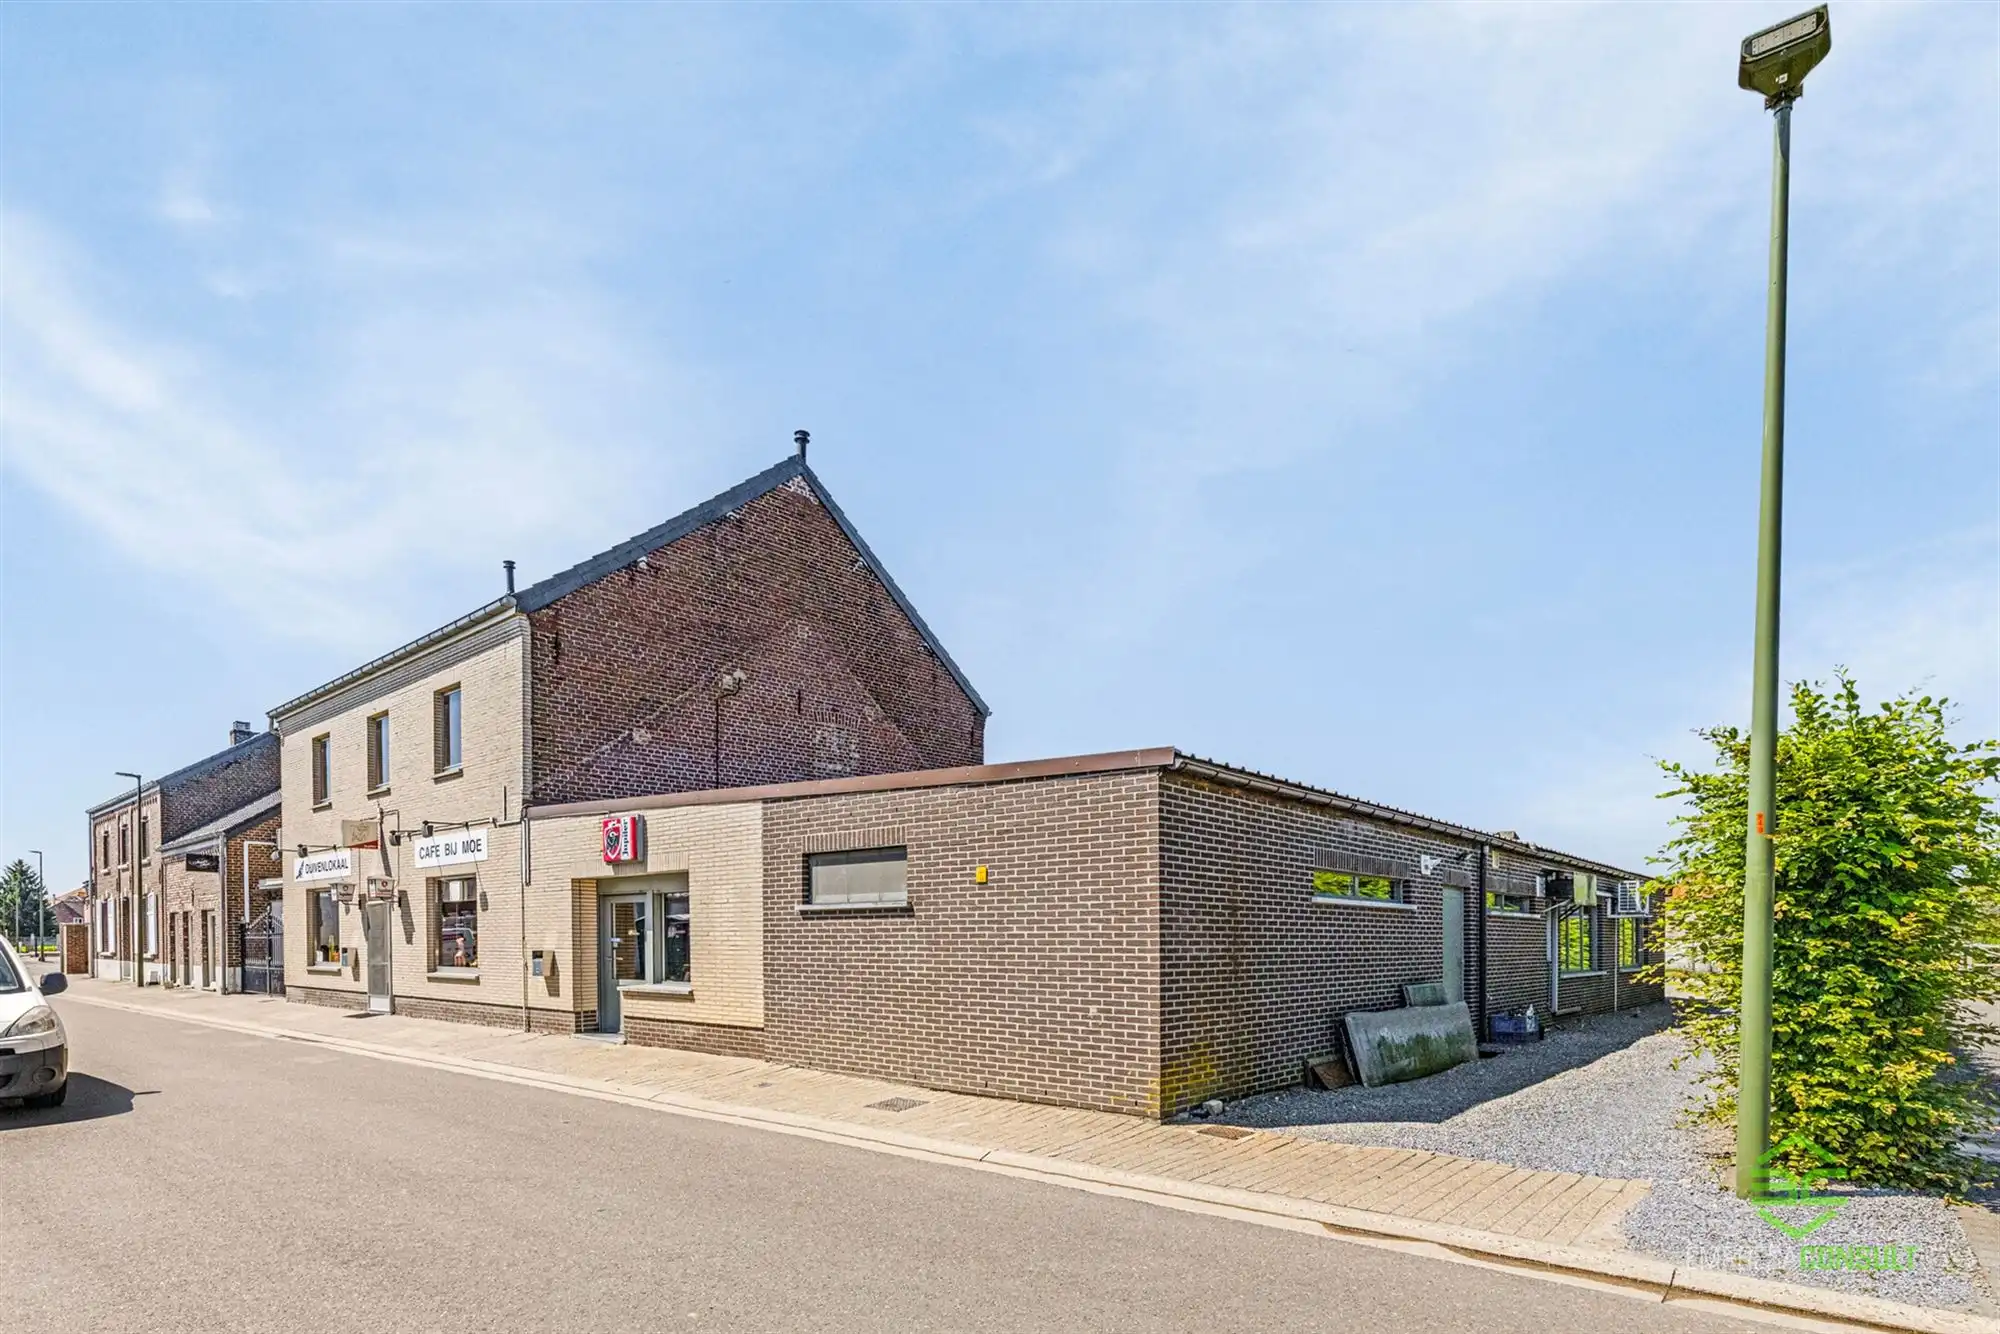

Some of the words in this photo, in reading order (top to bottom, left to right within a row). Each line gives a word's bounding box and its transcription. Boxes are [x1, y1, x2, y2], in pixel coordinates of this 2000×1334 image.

[621, 818, 629, 855] Jupiler
[419, 844, 441, 860] CAFE
[444, 842, 458, 856] BIJ
[461, 839, 482, 854] MOE
[305, 857, 348, 874] DUIVENLOKAAL
